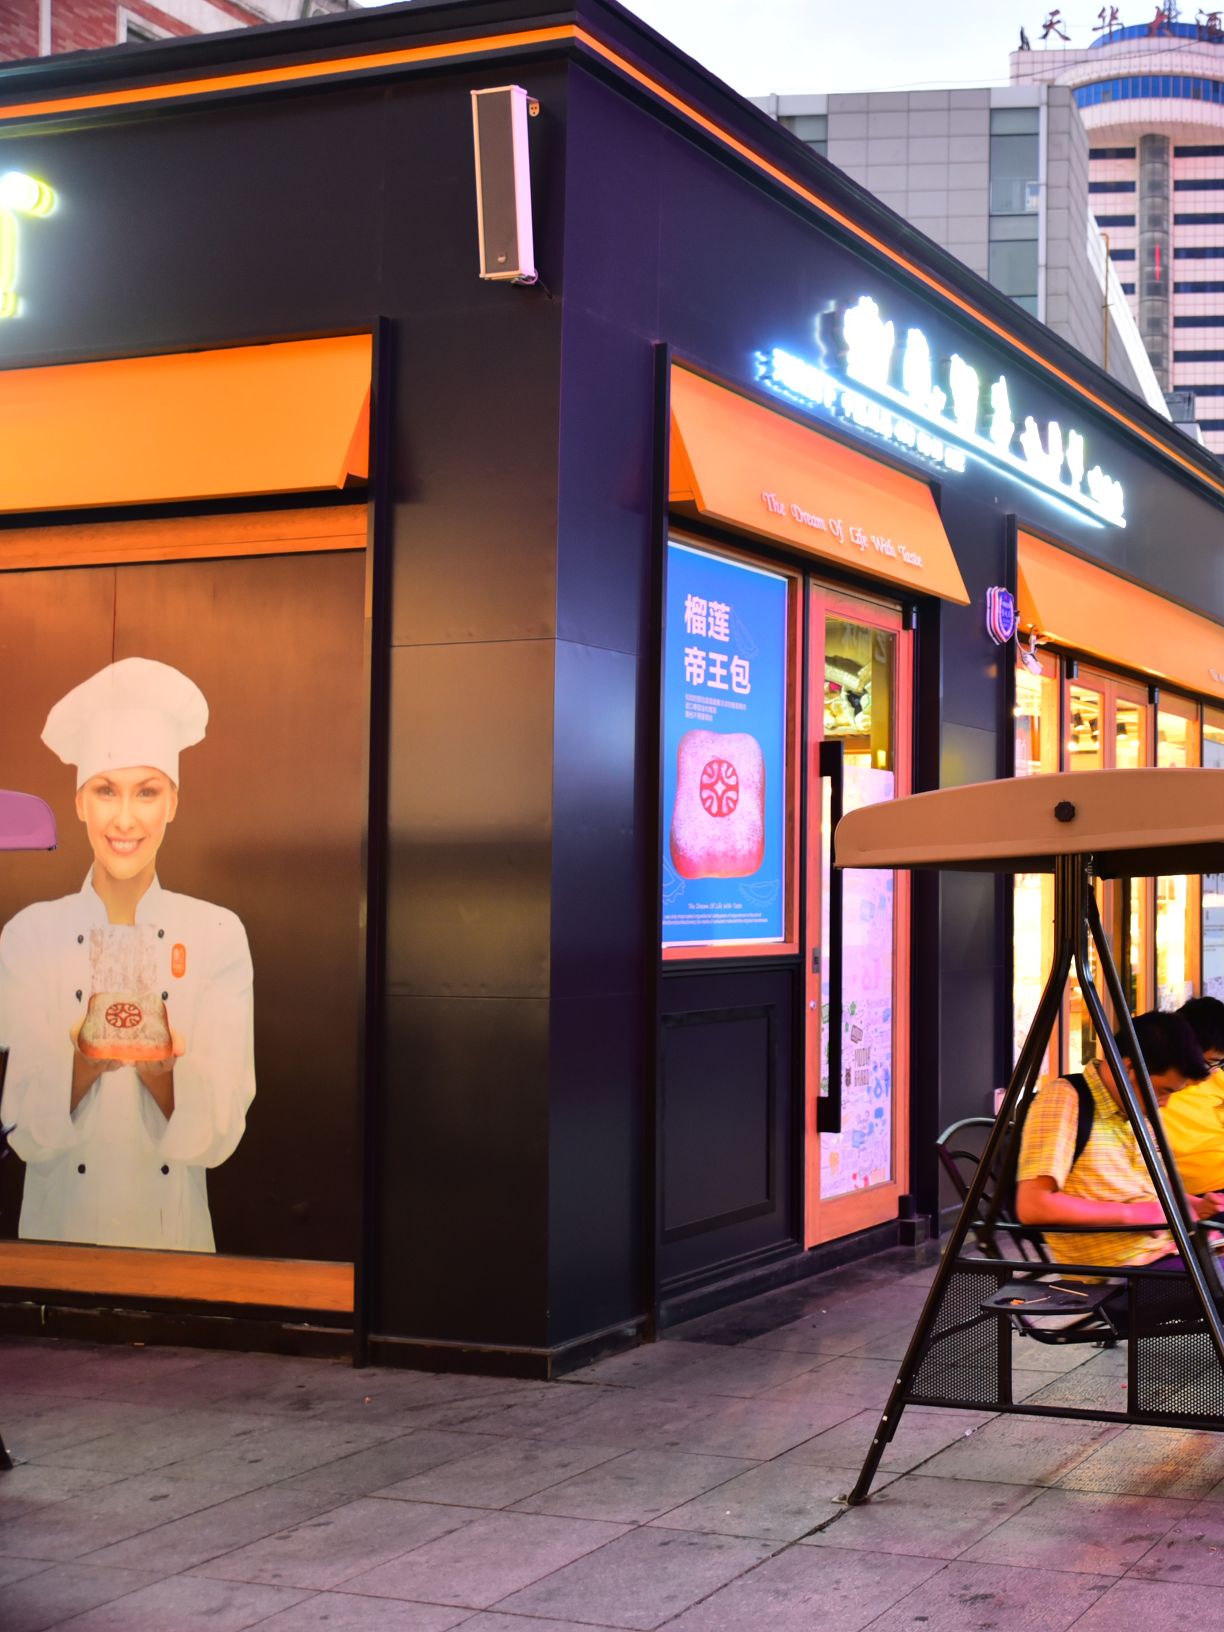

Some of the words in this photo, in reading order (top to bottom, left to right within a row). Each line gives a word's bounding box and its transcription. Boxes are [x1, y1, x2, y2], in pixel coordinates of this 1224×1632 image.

[762, 492, 786, 517] The
[791, 504, 826, 531] Dream
[828, 518, 844, 544] Of
[849, 526, 869, 551] Life
[871, 535, 897, 558] With
[897, 545, 924, 568] Taste
[684, 594, 731, 642] 榴莲
[684, 646, 751, 694] 帝王包
